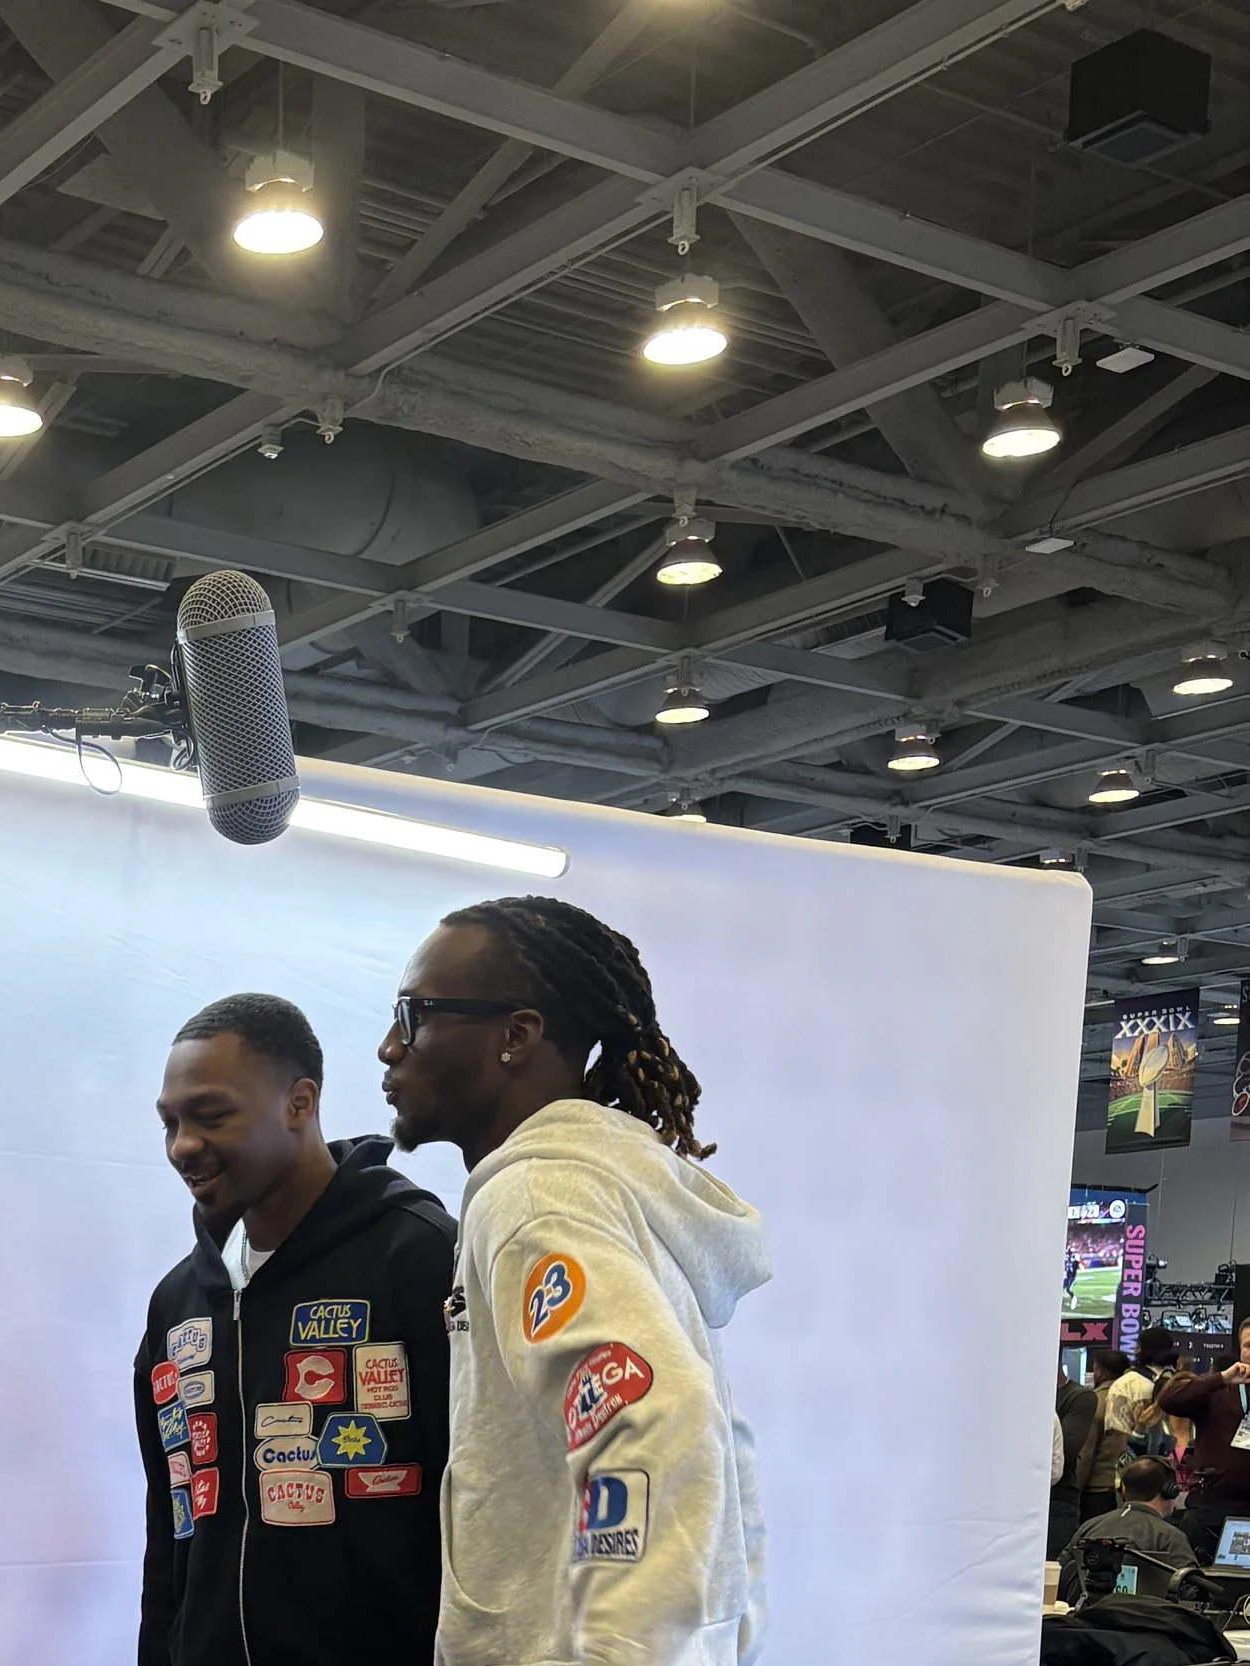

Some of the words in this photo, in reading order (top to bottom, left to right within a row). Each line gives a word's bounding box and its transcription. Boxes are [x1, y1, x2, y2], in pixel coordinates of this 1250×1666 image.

[1122, 1010, 1157, 1020] SUPER
[1162, 1005, 1191, 1014] BOWL
[1114, 1012, 1196, 1039] XXXIX
[1122, 1224, 1146, 1297] SUPER
[310, 1304, 351, 1319] CACTUS
[297, 1318, 362, 1340] VALLEY
[1121, 1304, 1140, 1359] BOW
[365, 1358, 398, 1369] CACTUS
[359, 1368, 405, 1386] VALLEY
[262, 1446, 316, 1464] Cactus
[267, 1482, 326, 1504] CACTUS
